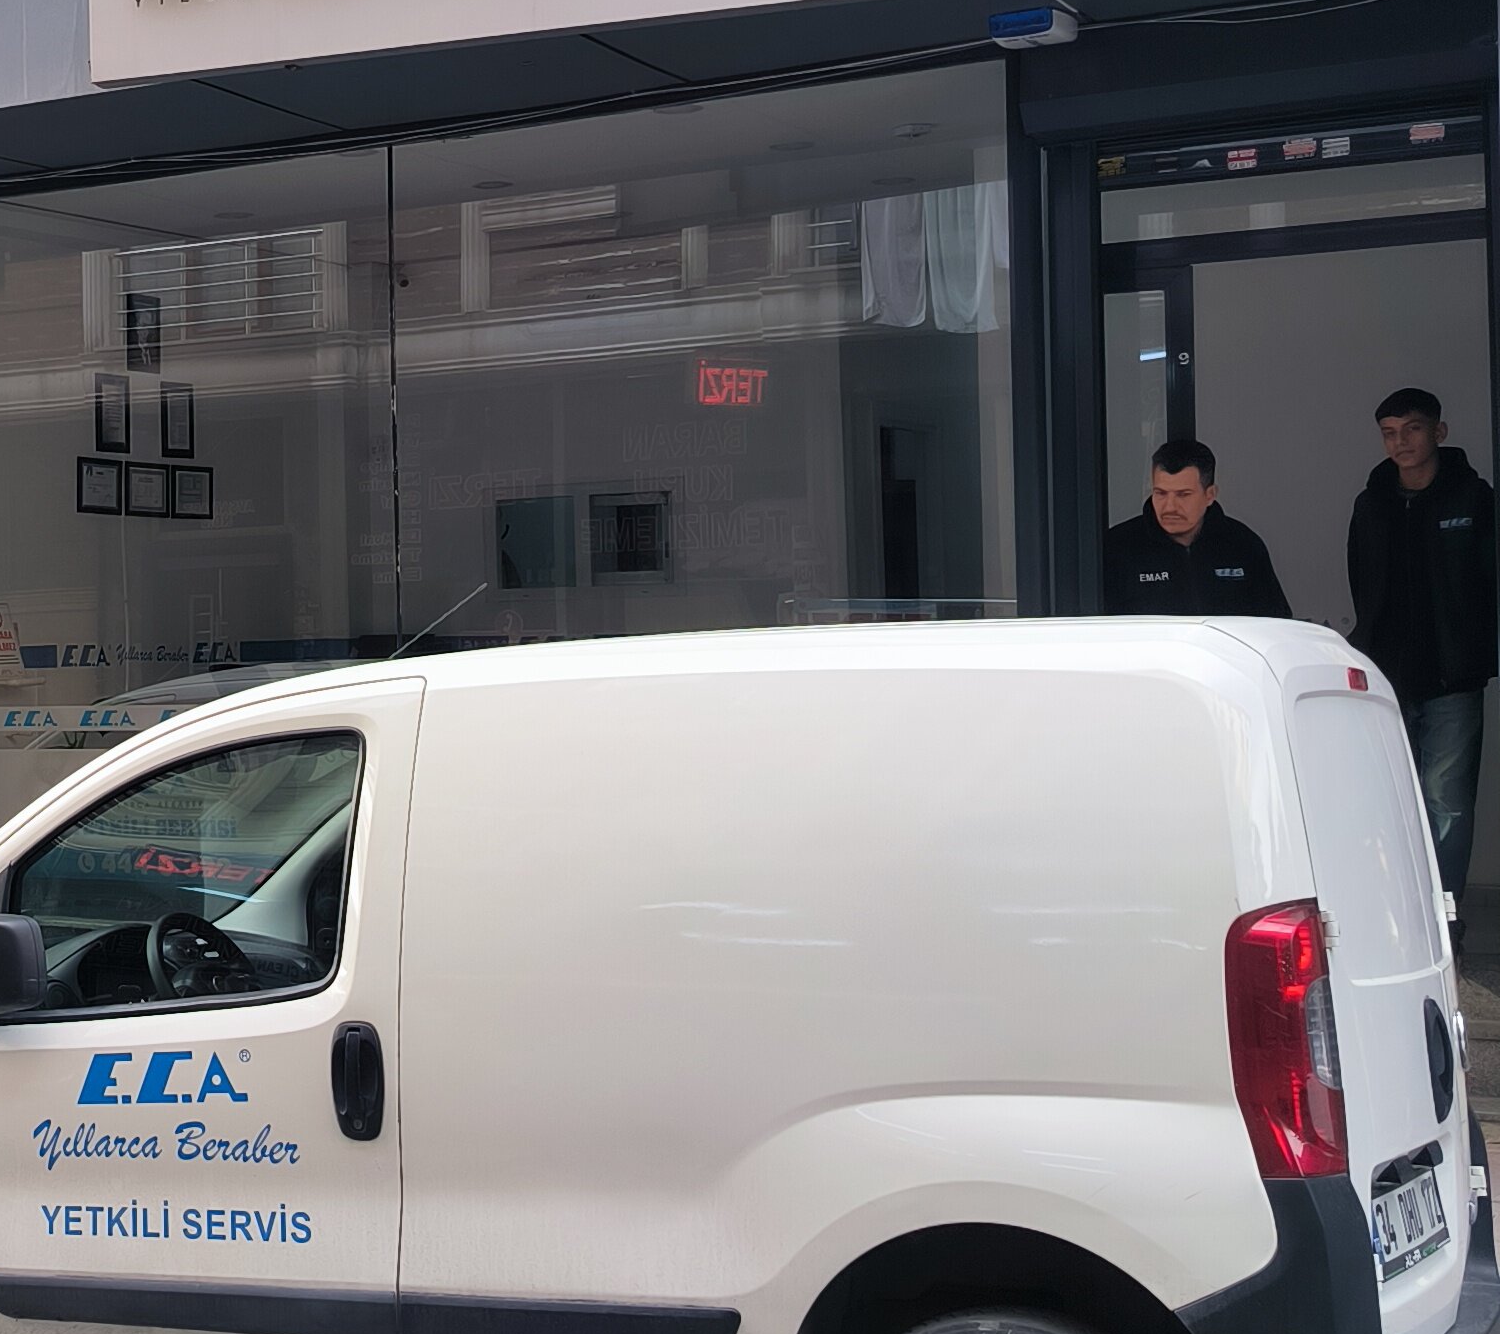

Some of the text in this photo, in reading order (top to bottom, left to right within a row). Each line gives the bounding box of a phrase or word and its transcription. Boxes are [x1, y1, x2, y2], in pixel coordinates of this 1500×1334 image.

[32, 1118, 301, 1171] Yıllarca Beraber
[41, 1199, 312, 1244] YETKİLİ SERVİS
[1376, 1200, 1398, 1255] 34
